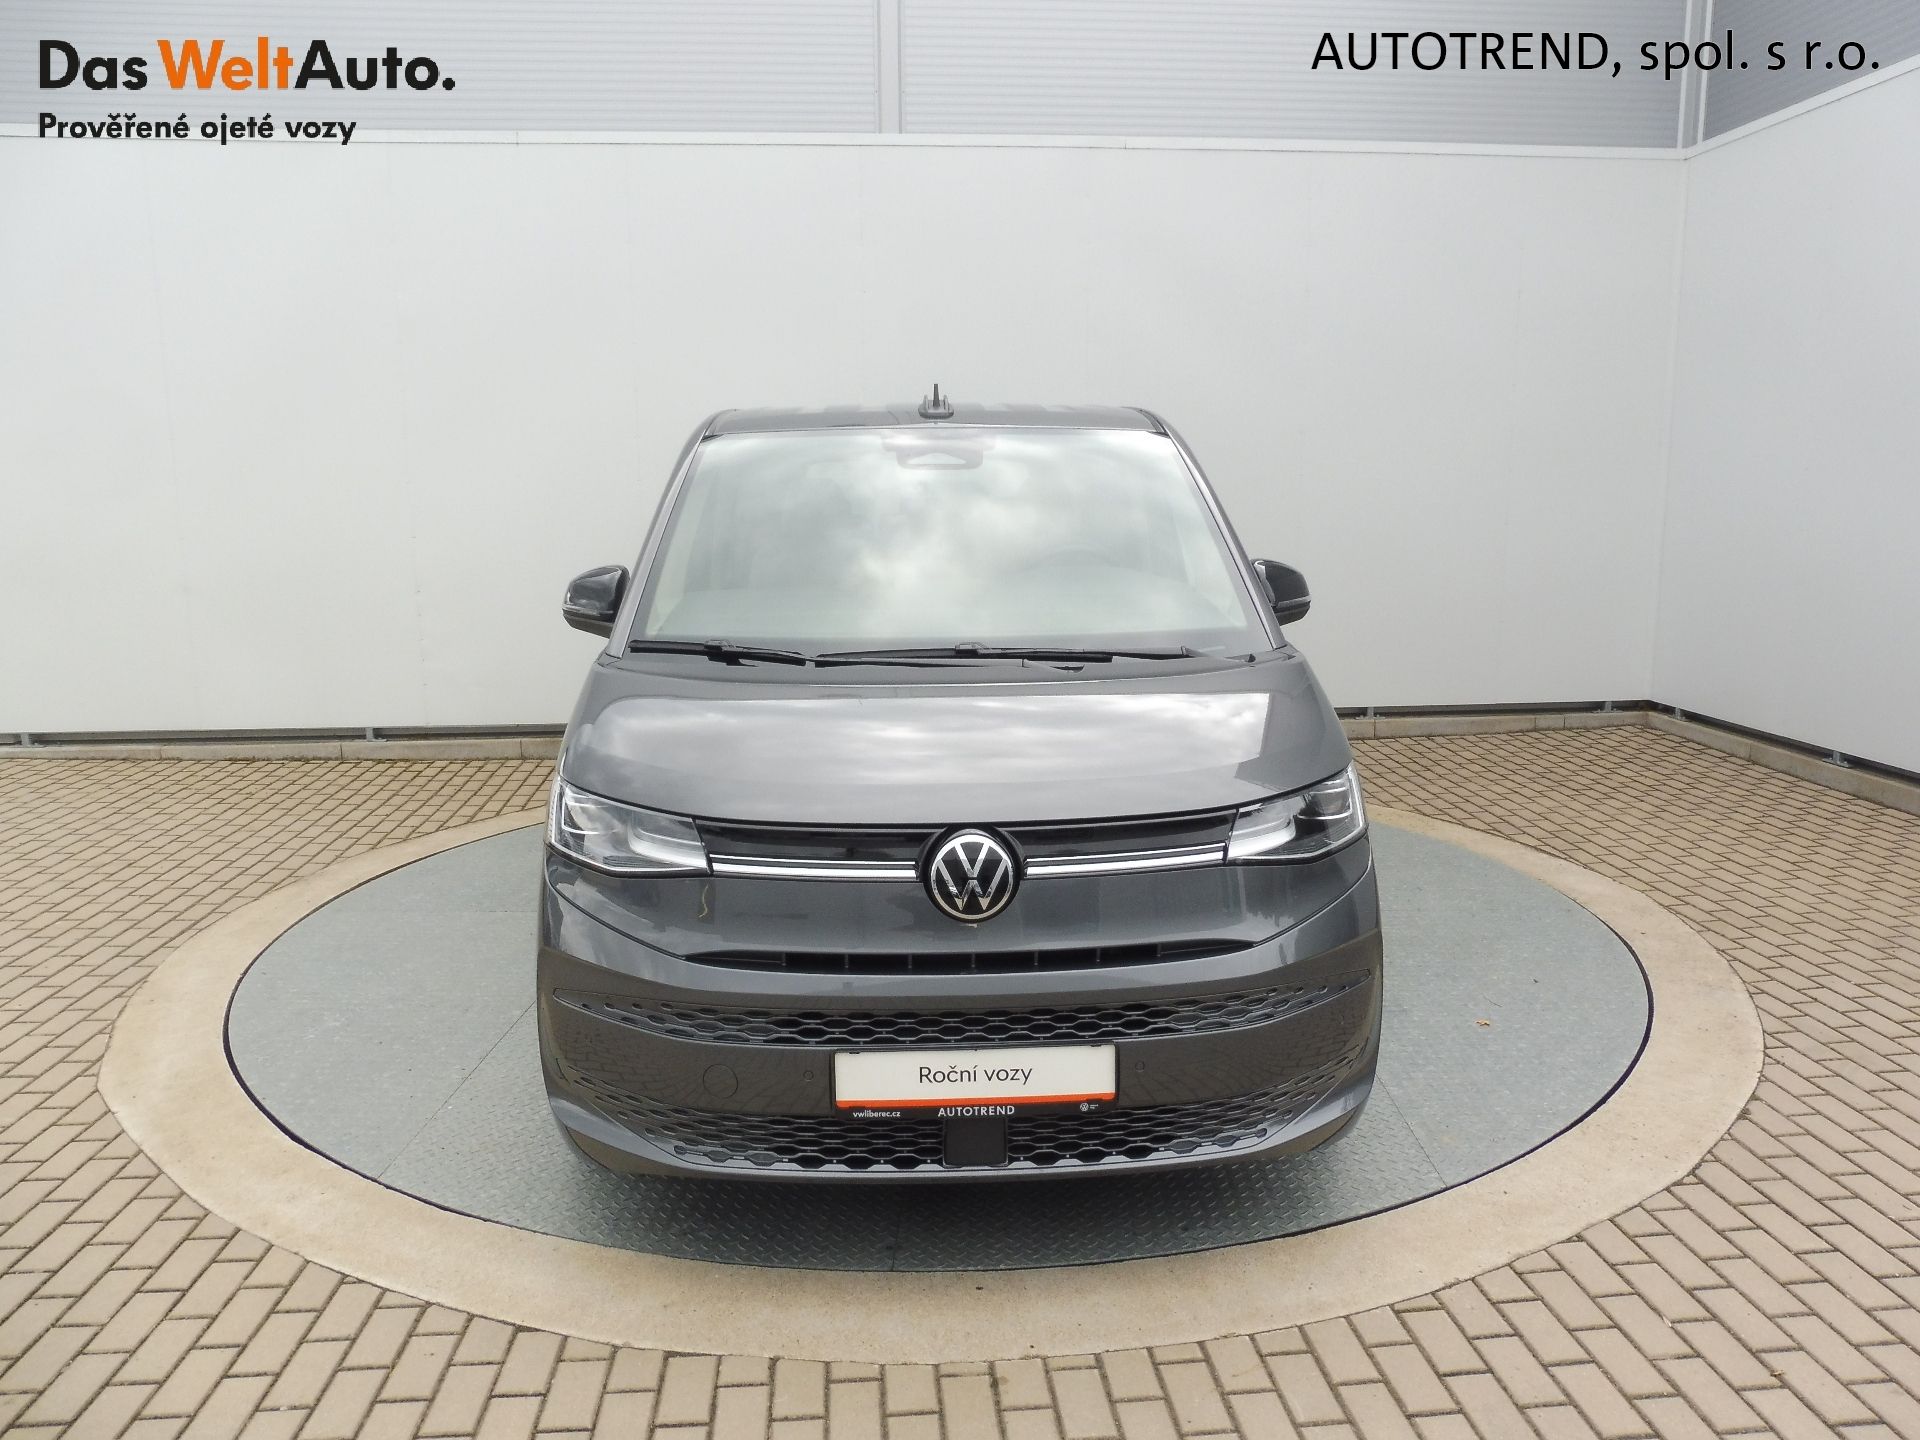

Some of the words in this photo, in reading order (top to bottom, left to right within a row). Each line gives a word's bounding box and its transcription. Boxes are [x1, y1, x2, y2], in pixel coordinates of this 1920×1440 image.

[919, 1064, 978, 1084] Roční
[984, 1067, 1033, 1086] vozy
[852, 1109, 901, 1118] vwliberec.cz
[937, 1105, 1015, 1117] AUTOTREND
